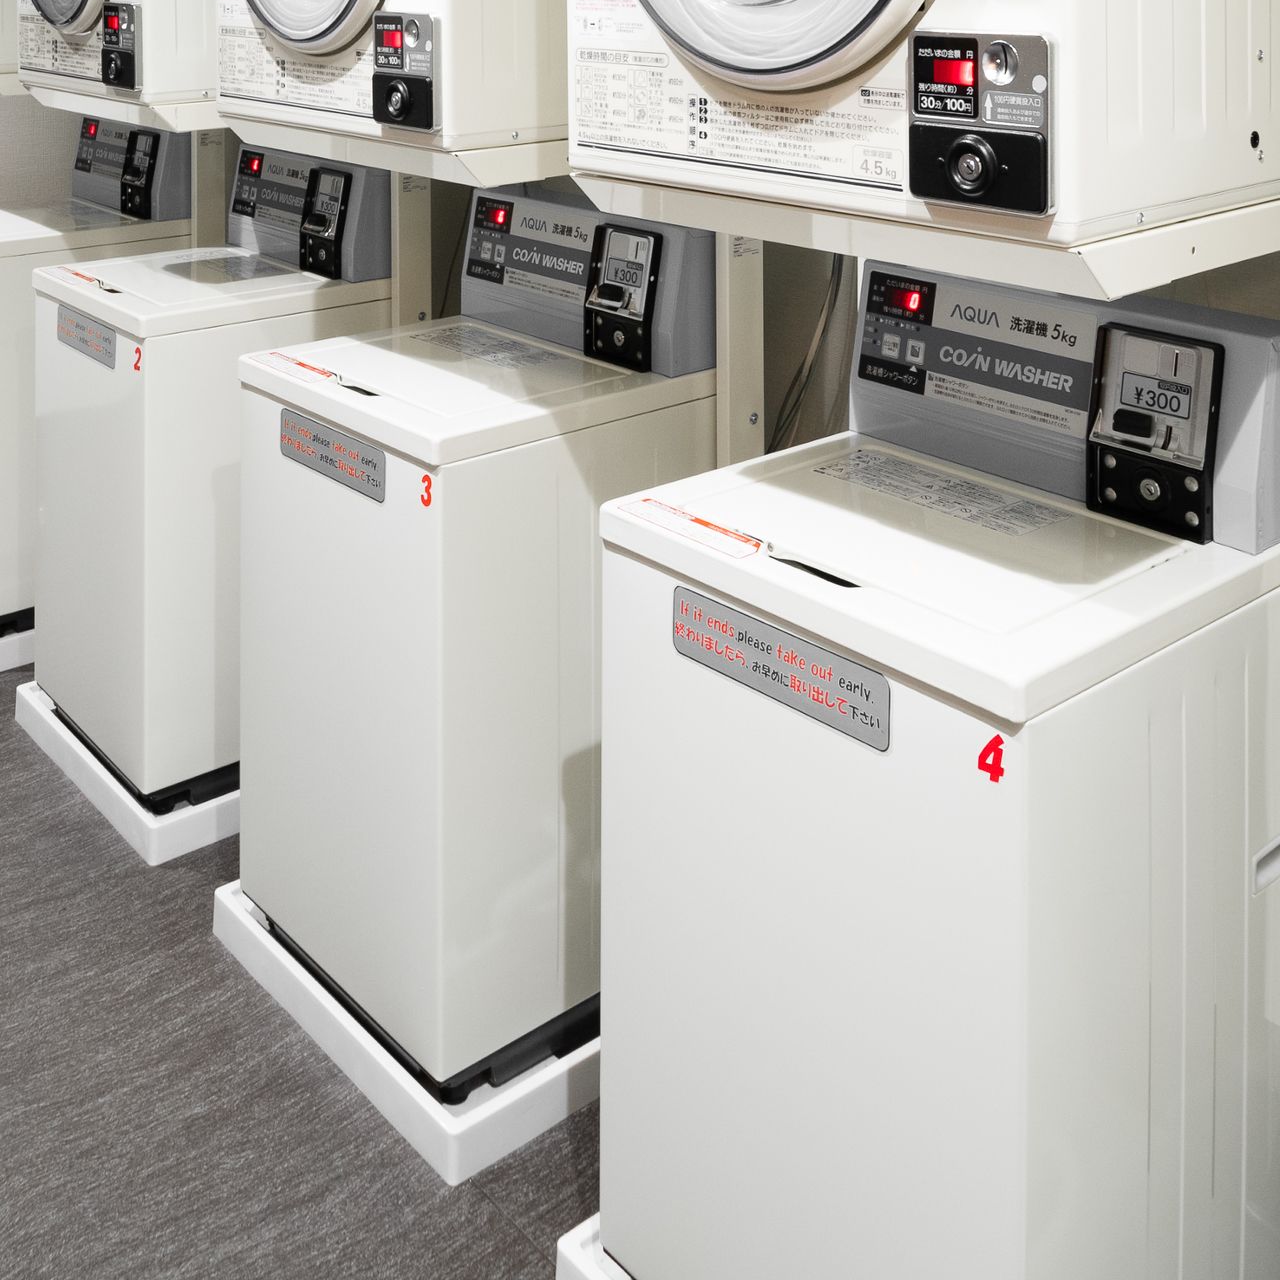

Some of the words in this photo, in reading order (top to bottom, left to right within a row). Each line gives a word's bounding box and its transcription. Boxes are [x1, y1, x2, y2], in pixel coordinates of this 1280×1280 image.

[966, 50, 973, 59] 円
[920, 96, 972, 112] 30分/100円
[966, 87, 973, 95] 分
[860, 159, 883, 176] 4.5
[886, 167, 897, 179] kg
[520, 216, 547, 233] AQUA
[551, 223, 572, 238] 洗濯機
[573, 226, 588, 243] 5kg
[512, 246, 541, 265] COIN
[542, 255, 584, 276] WASHER
[614, 267, 638, 284] ¥300
[909, 293, 919, 309] 0
[950, 304, 1000, 328] AQUA
[1009, 316, 1048, 338] 洗濯機
[1051, 324, 1077, 347] 5kg
[133, 346, 142, 371] 2
[939, 346, 990, 372] COIN
[995, 359, 1073, 392] WASHER
[1134, 386, 1180, 413] ¥300
[421, 474, 432, 507] 3
[680, 600, 689, 616] If
[693, 606, 703, 622] it
[776, 643, 806, 670] take
[811, 661, 833, 682] out
[838, 675, 875, 705] early.
[978, 734, 1005, 783] 4
